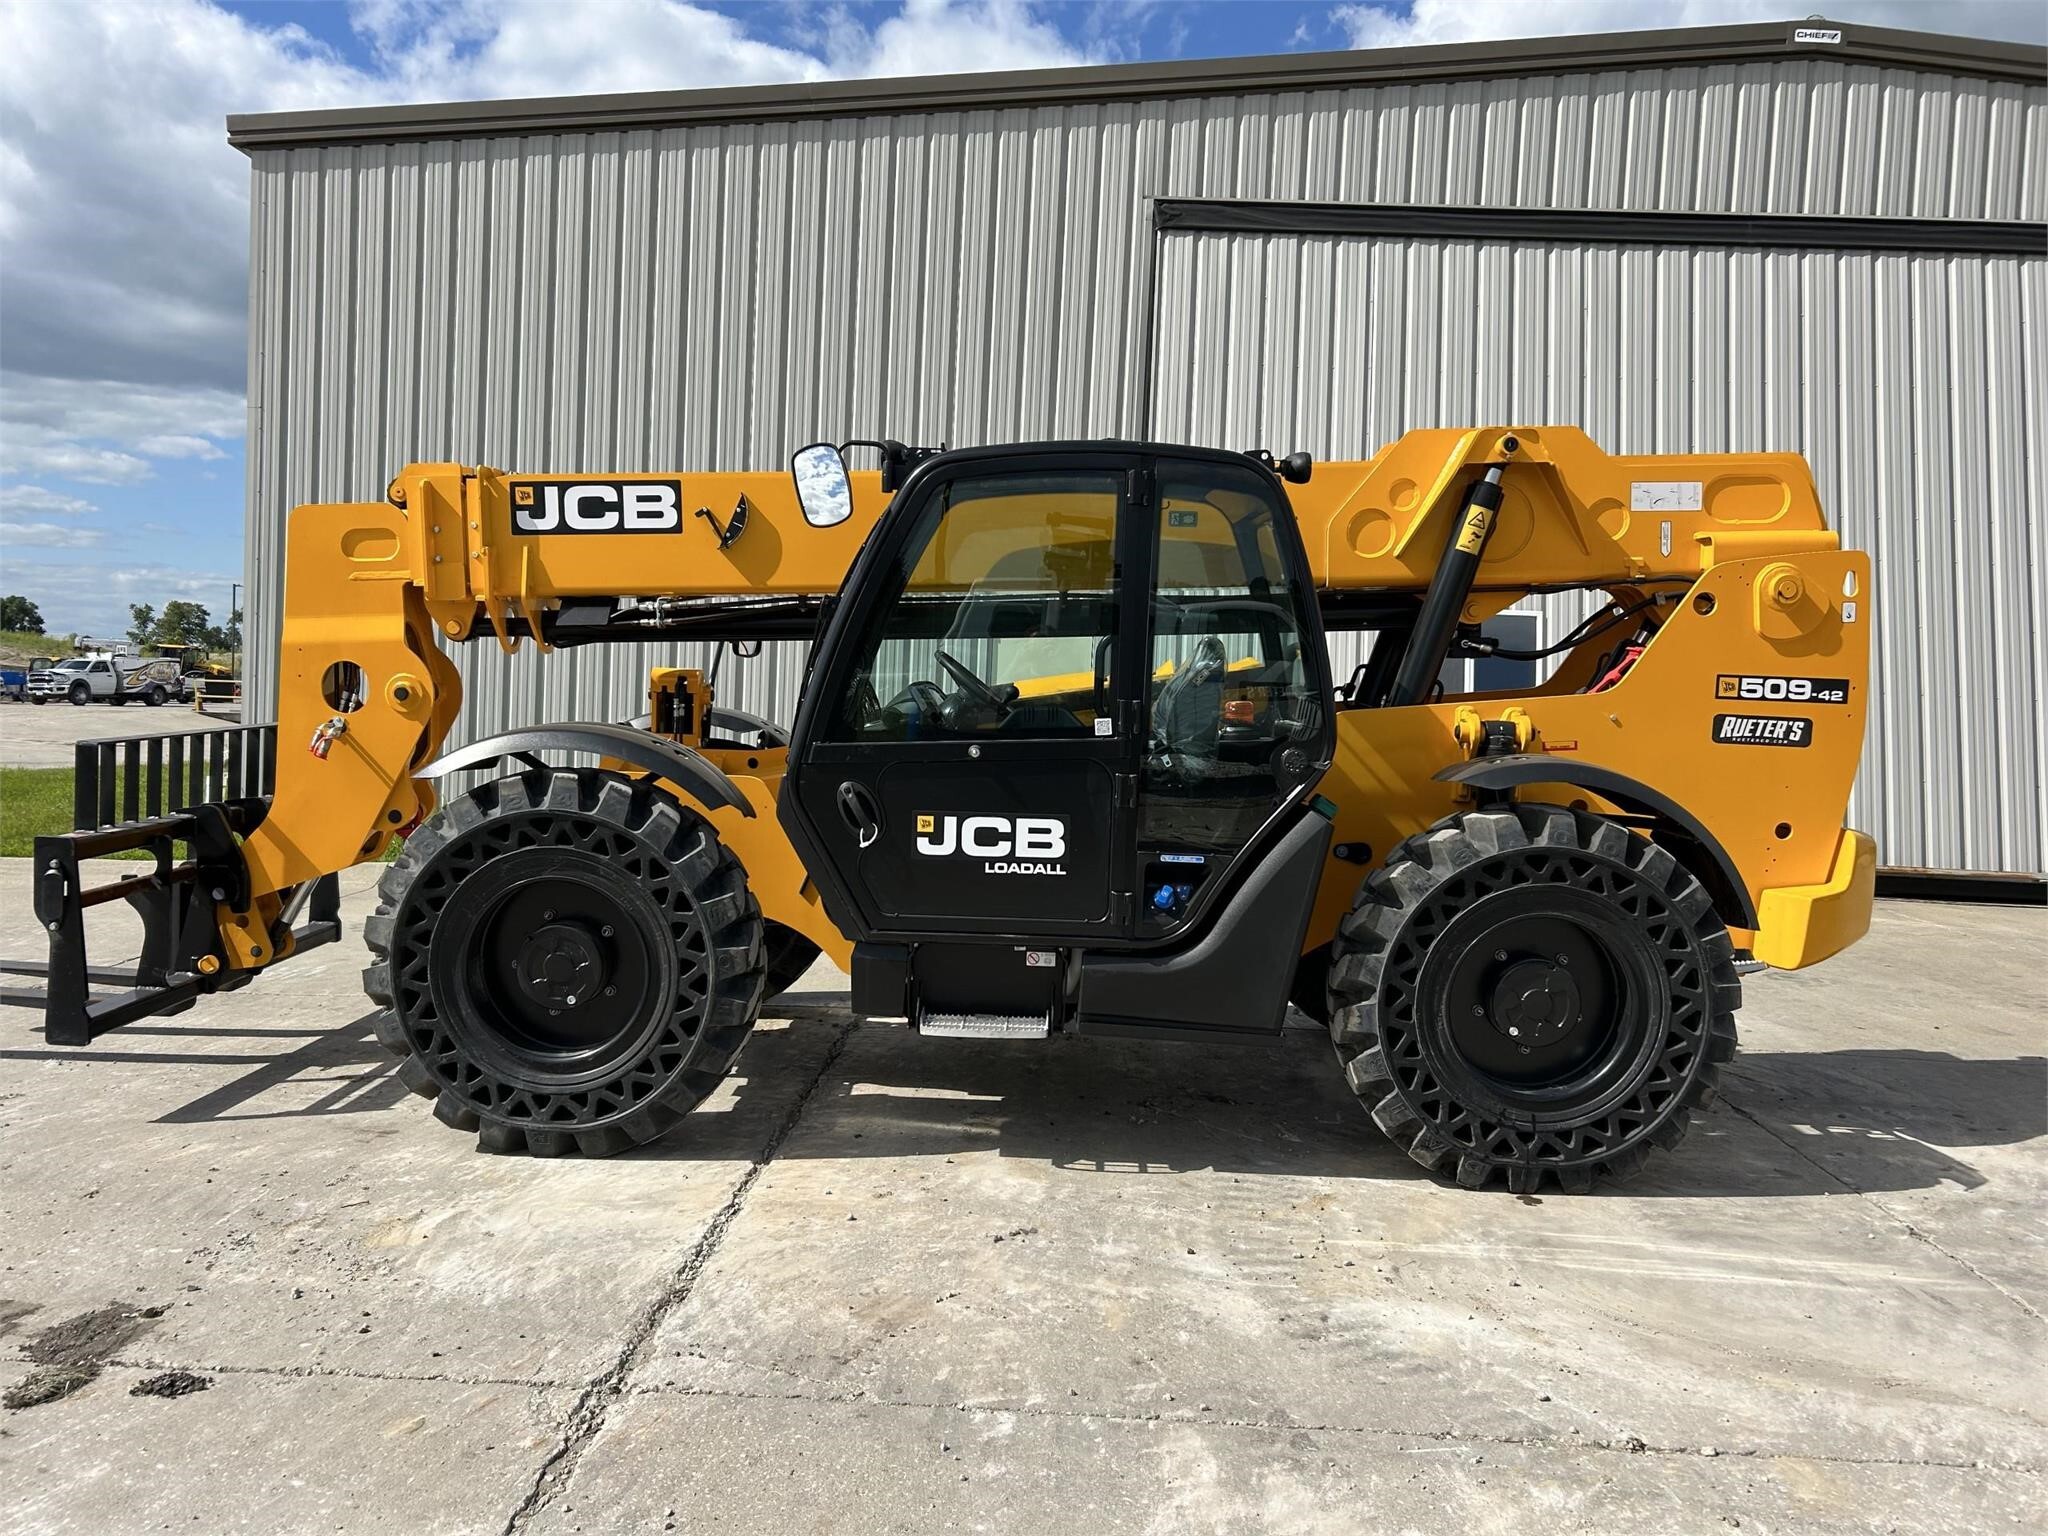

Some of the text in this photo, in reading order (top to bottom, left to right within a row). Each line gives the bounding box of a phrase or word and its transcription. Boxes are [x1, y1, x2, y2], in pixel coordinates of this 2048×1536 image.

[1797, 31, 1828, 39] CHIEF
[516, 485, 678, 530] JCB
[1740, 677, 1843, 702] 509-42
[1719, 716, 1805, 741] RUETER'S
[917, 816, 1066, 858] JCB
[985, 862, 1066, 875] LOADALL
